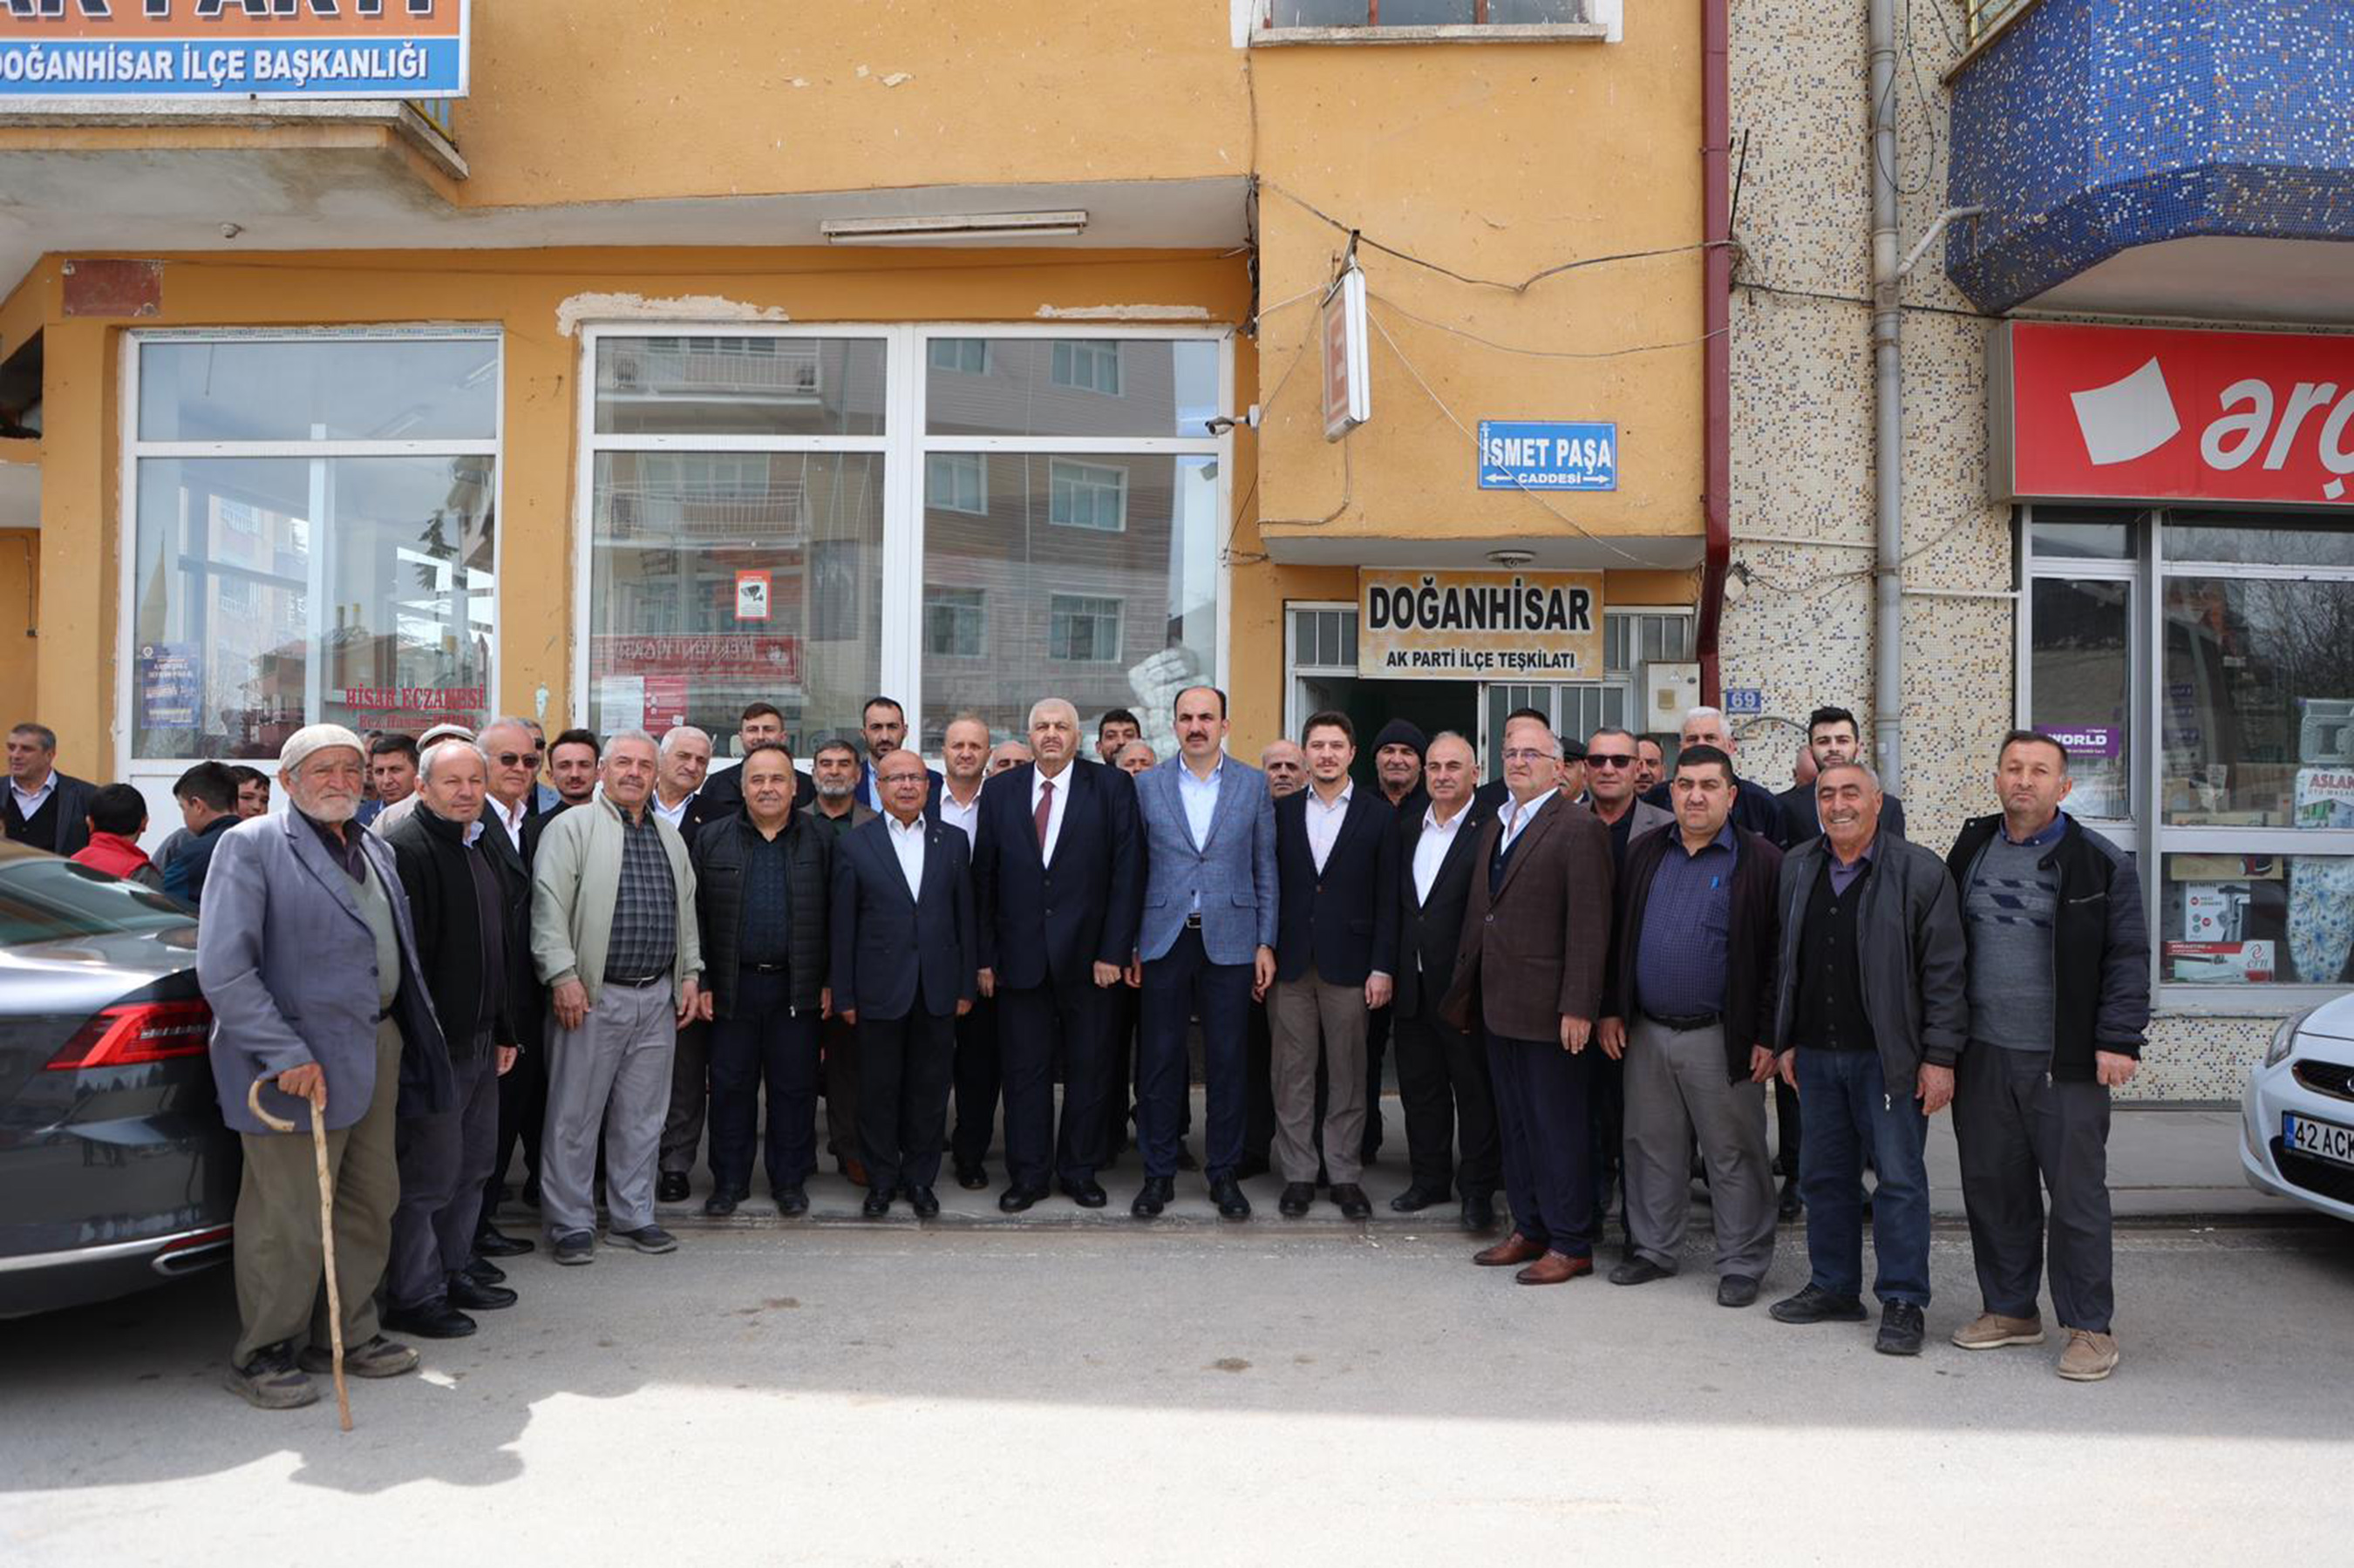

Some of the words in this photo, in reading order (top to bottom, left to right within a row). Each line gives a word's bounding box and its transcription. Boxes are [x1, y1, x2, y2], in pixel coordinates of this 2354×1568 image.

[0, 44, 174, 81] OĞANHİSAR
[182, 44, 246, 87] İLÇE
[254, 41, 427, 86] BAŞKANLIĞI
[1482, 431, 1550, 468] İSMET
[1556, 438, 1613, 475] PAŞA
[1518, 472, 1582, 484] CADDESİ
[1370, 577, 1590, 630] DOĞANHİSAR
[1386, 651, 1408, 668] AK
[1412, 648, 1456, 668] PARTİ
[1460, 648, 1493, 671] İLÇE
[1498, 649, 1575, 669] TEŞKİLATI
[345, 682, 397, 708] HİSAR
[1731, 692, 1756, 707] 69
[2296, 1120, 2318, 1151] 42
